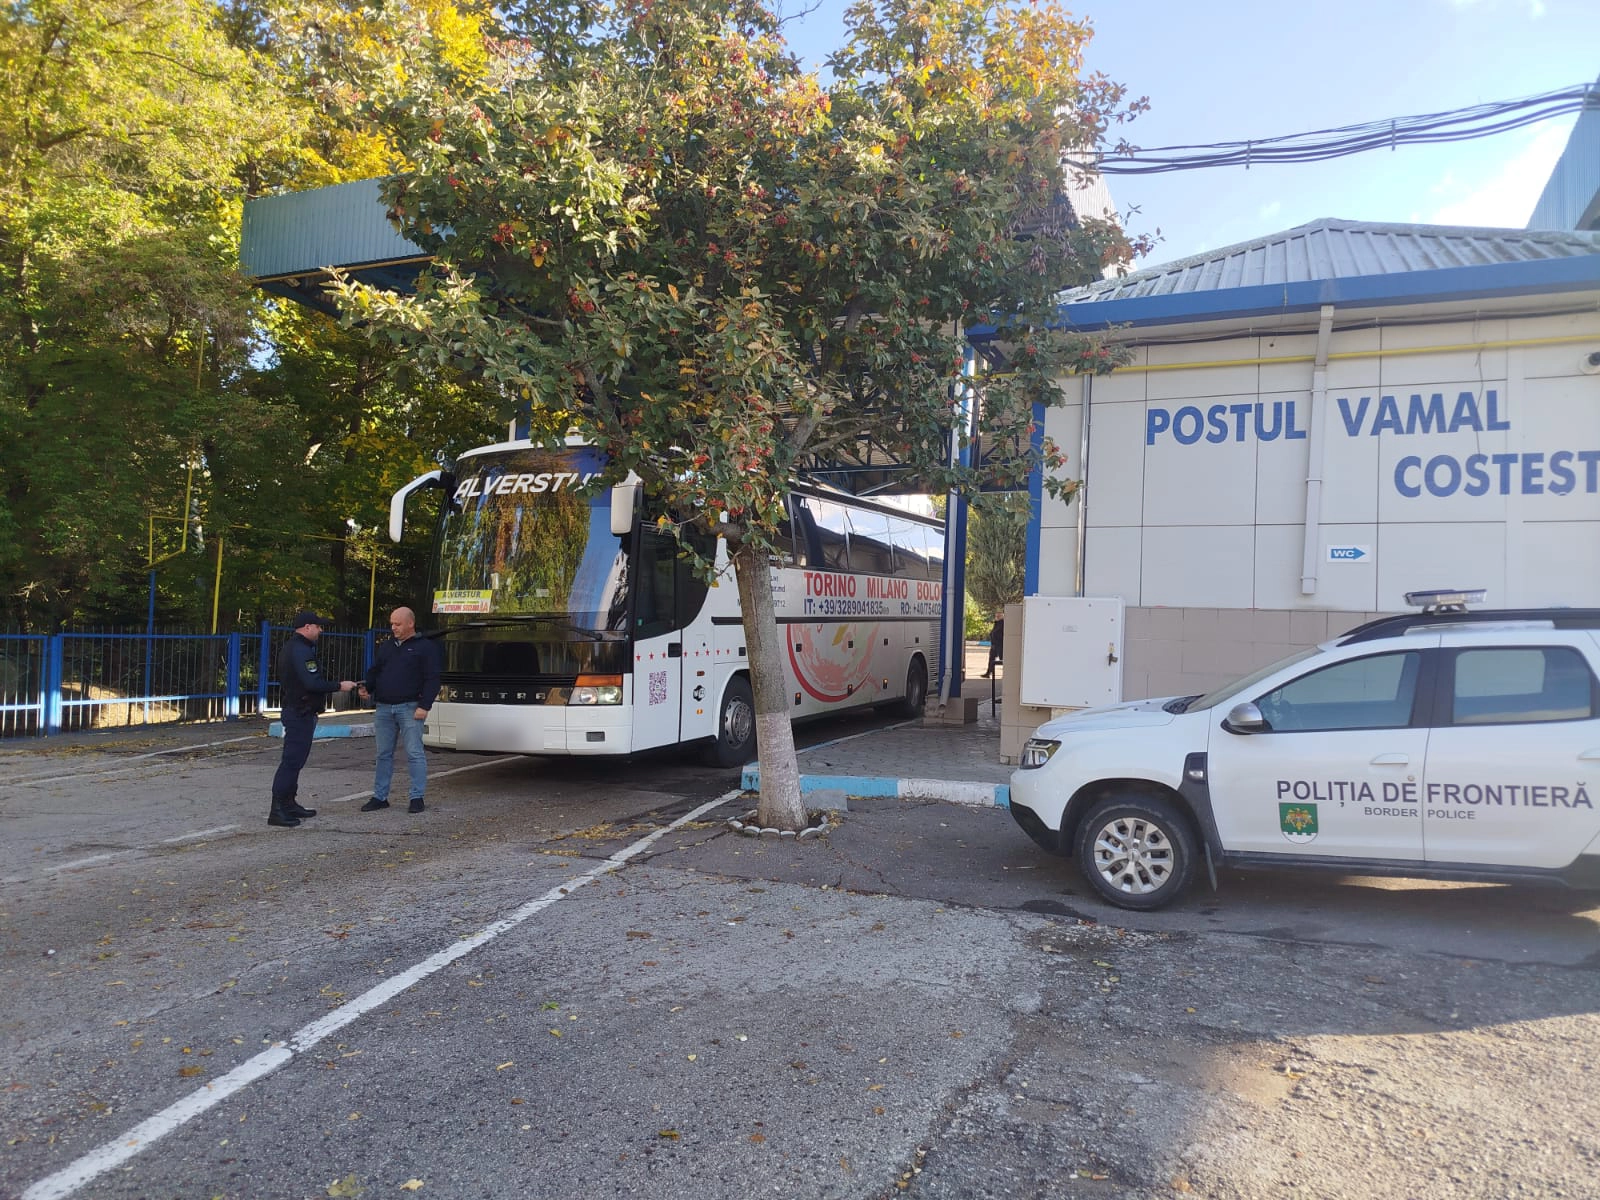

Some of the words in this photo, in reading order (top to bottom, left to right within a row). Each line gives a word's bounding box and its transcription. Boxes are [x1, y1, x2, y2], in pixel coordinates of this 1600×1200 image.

[1146, 401, 1307, 446] POSTUL
[1337, 390, 1511, 437] VAMAL
[452, 472, 602, 499] ALVERSTU
[1333, 550, 1355, 558] WC
[804, 572, 857, 598] TORINO
[866, 577, 909, 600] MILANO
[916, 581, 943, 601] BOLO
[804, 599, 816, 615] IT:
[1276, 780, 1376, 808] POLIȚIA
[1383, 782, 1418, 803] DE
[1427, 782, 1594, 809] FRONTIERĂ
[1364, 807, 1419, 818] BORDER
[1428, 809, 1475, 820] POLICE
